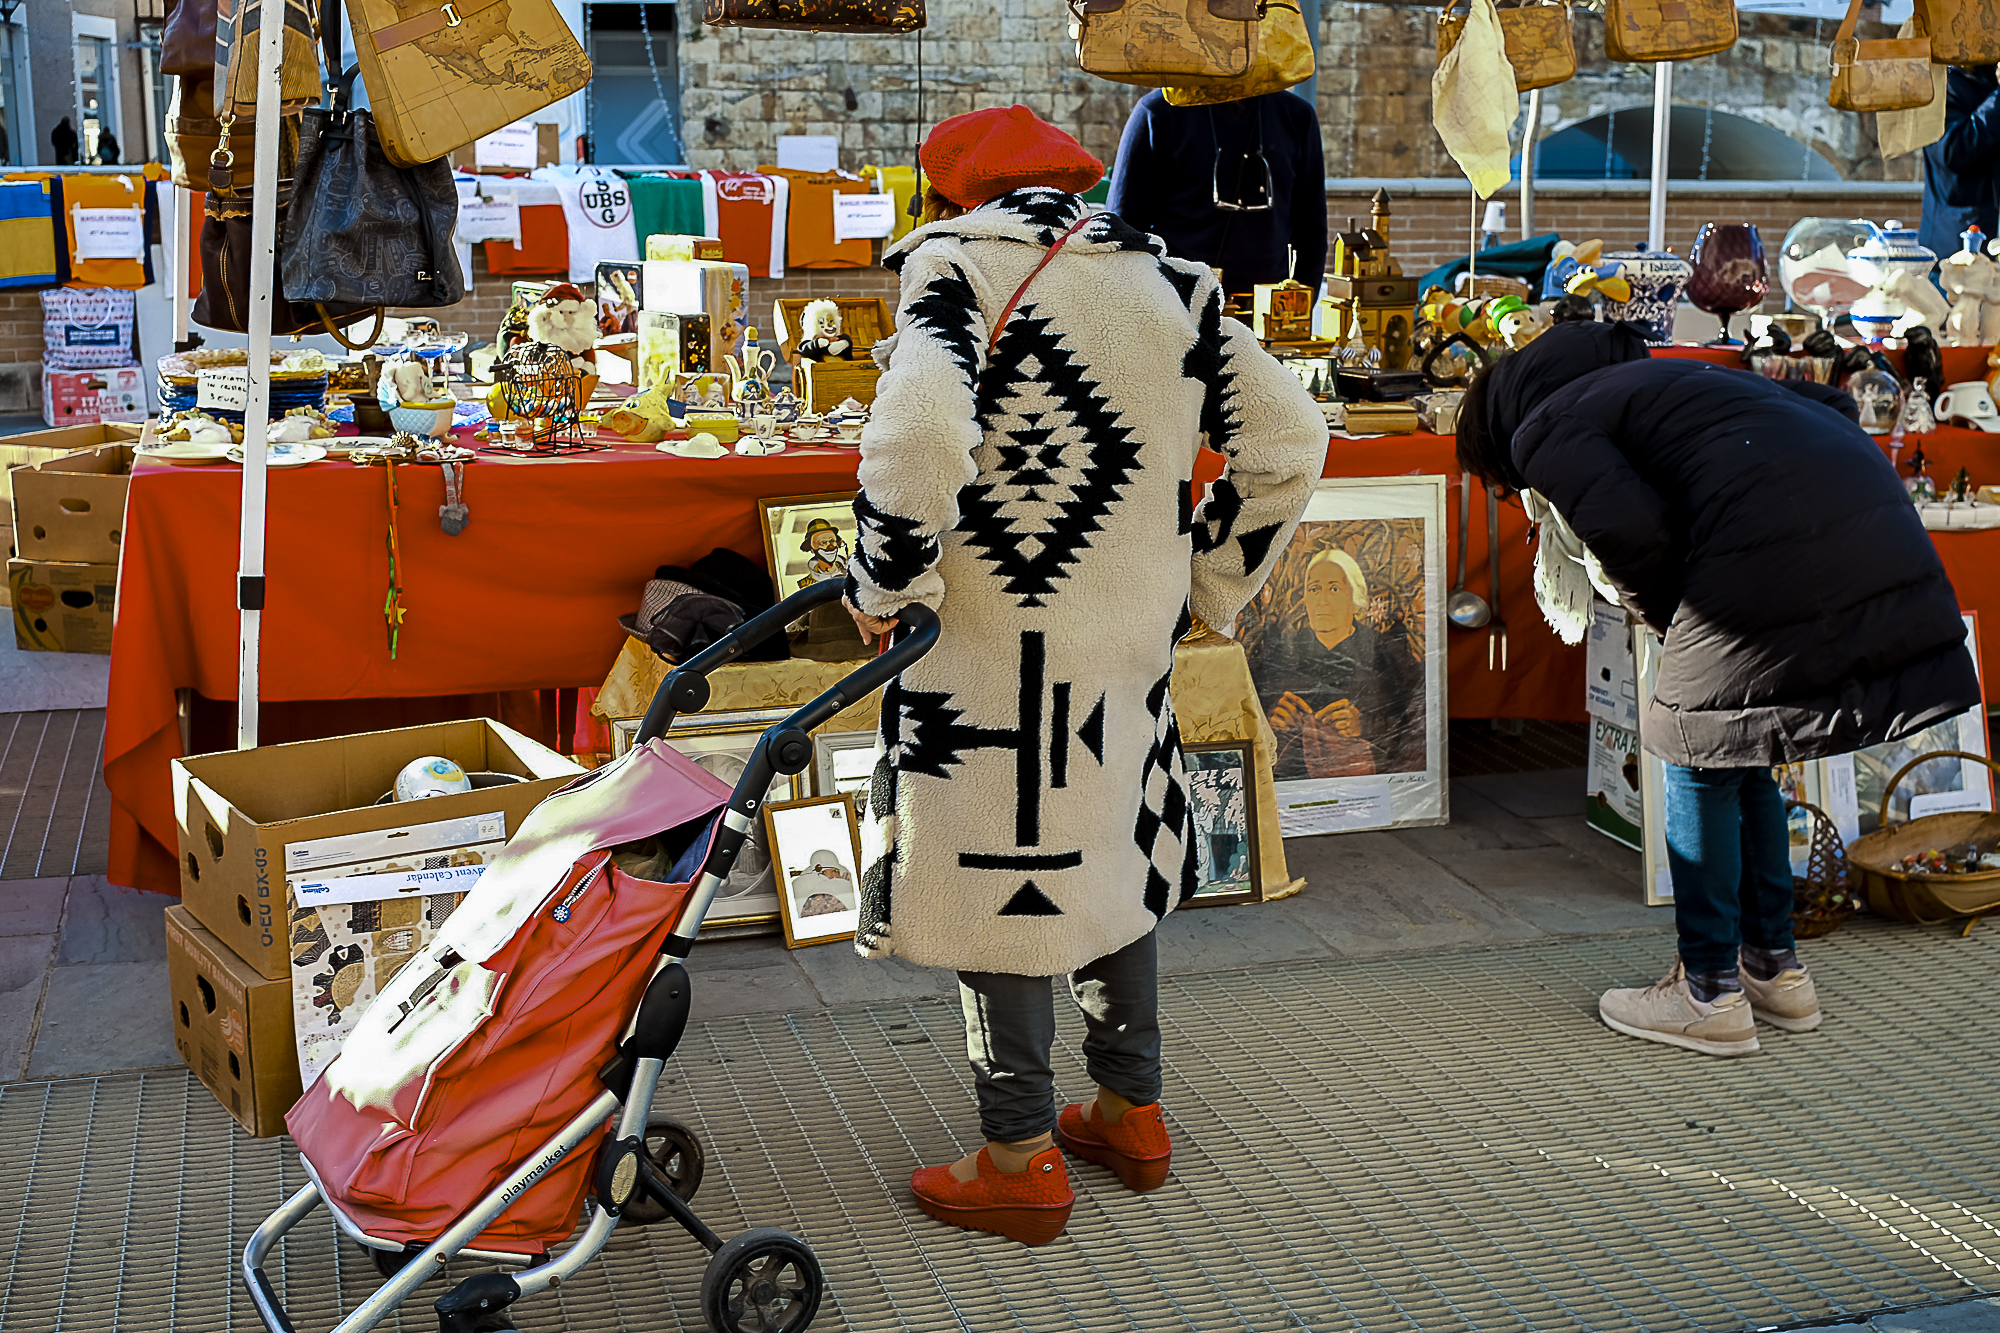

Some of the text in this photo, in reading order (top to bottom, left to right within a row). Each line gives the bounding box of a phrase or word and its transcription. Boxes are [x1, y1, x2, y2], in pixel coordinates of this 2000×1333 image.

[584, 191, 626, 208] UBS
[602, 208, 615, 223] G
[406, 867, 486, 883] dvent Calendar
[501, 1144, 568, 1204] playmarket
